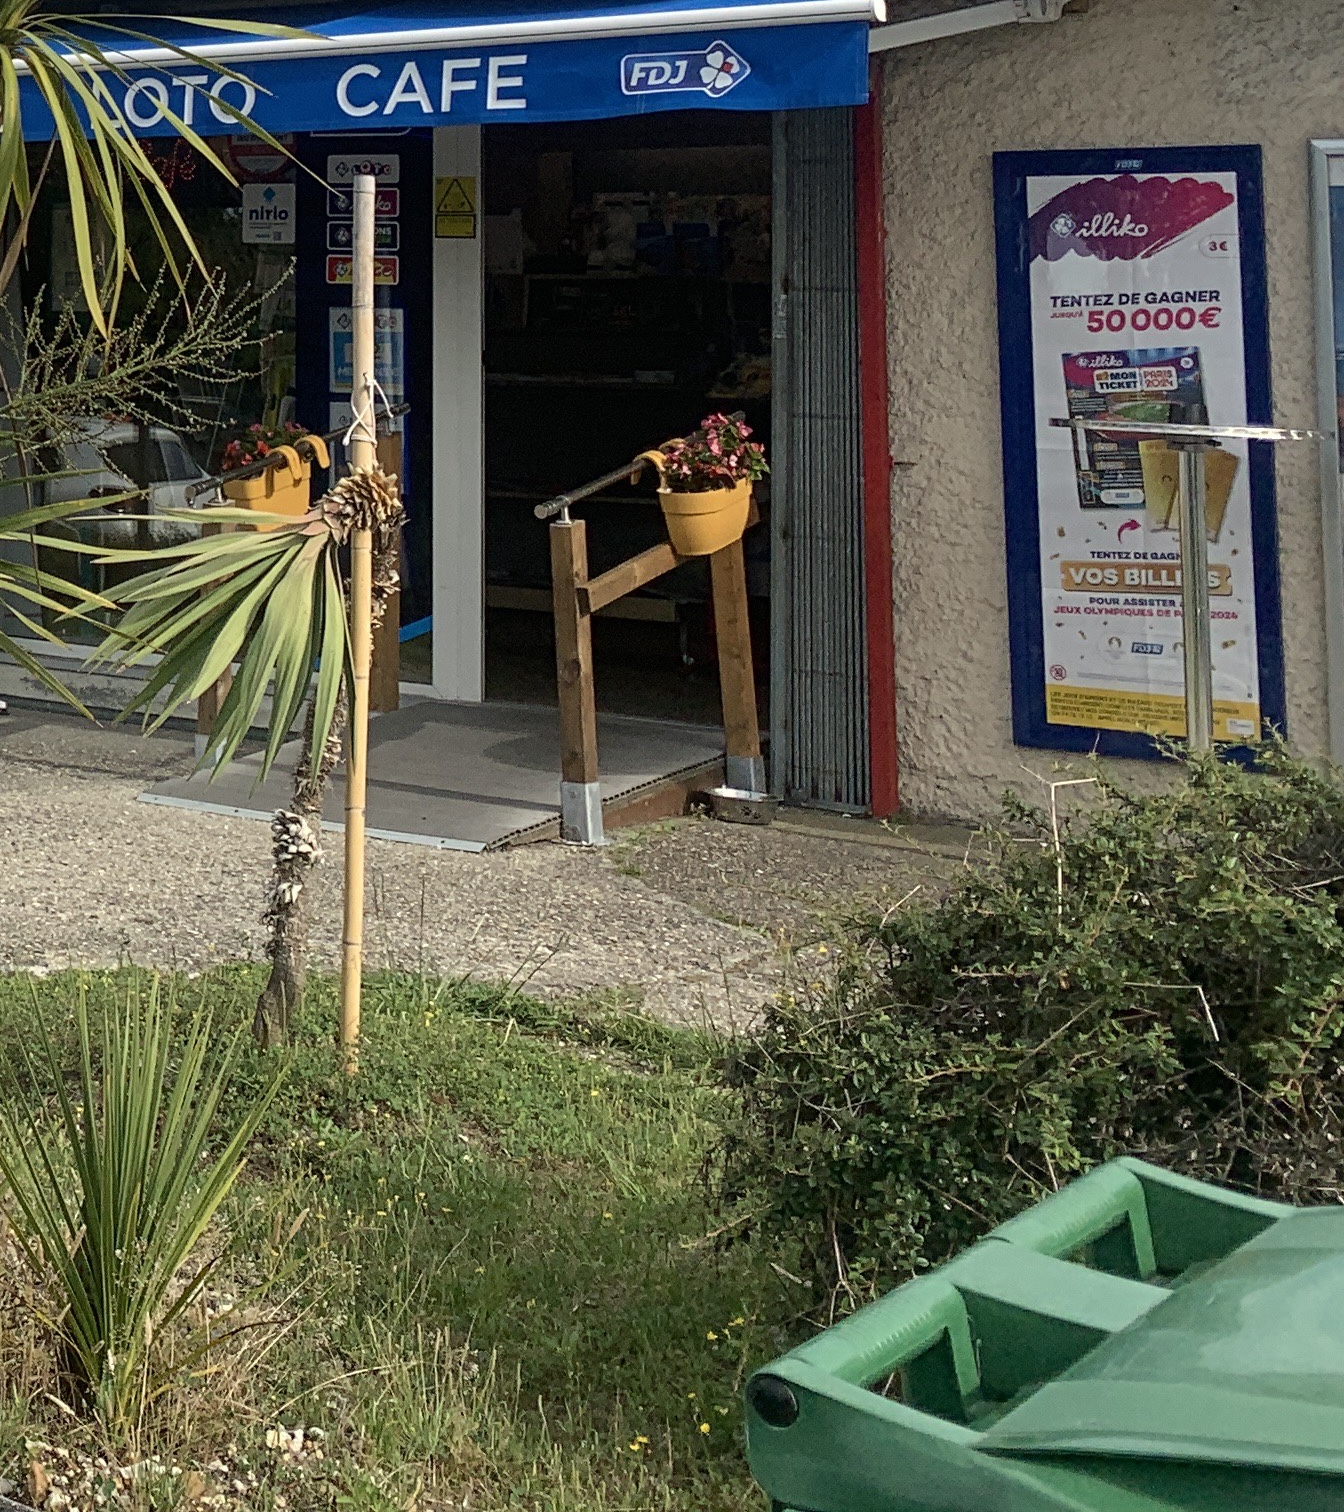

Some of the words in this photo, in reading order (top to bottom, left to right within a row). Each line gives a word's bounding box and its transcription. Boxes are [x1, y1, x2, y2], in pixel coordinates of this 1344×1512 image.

[335, 54, 528, 118] CAFE
[629, 59, 689, 88] FDJ
[249, 207, 289, 221] nirio
[1075, 212, 1149, 239] illiko
[1049, 294, 1114, 308] TENTEZ
[1118, 292, 1141, 306] DE
[1144, 289, 1221, 305] GAGNER
[1087, 309, 1126, 333] 50
[1130, 306, 1223, 332] 000€
[1109, 371, 1139, 381] MON
[1099, 379, 1139, 390] TICKET
[1089, 551, 1132, 561] TENTEZ
[1134, 552, 1148, 561] DE
[1069, 567, 1118, 587] VOS
[1089, 597, 1120, 607] POUR
[1123, 598, 1176, 609] ASSISTER
[1053, 606, 1082, 616] JEUX
[1084, 606, 1154, 619] OLYMPIQUES
[1157, 609, 1172, 619] DE
